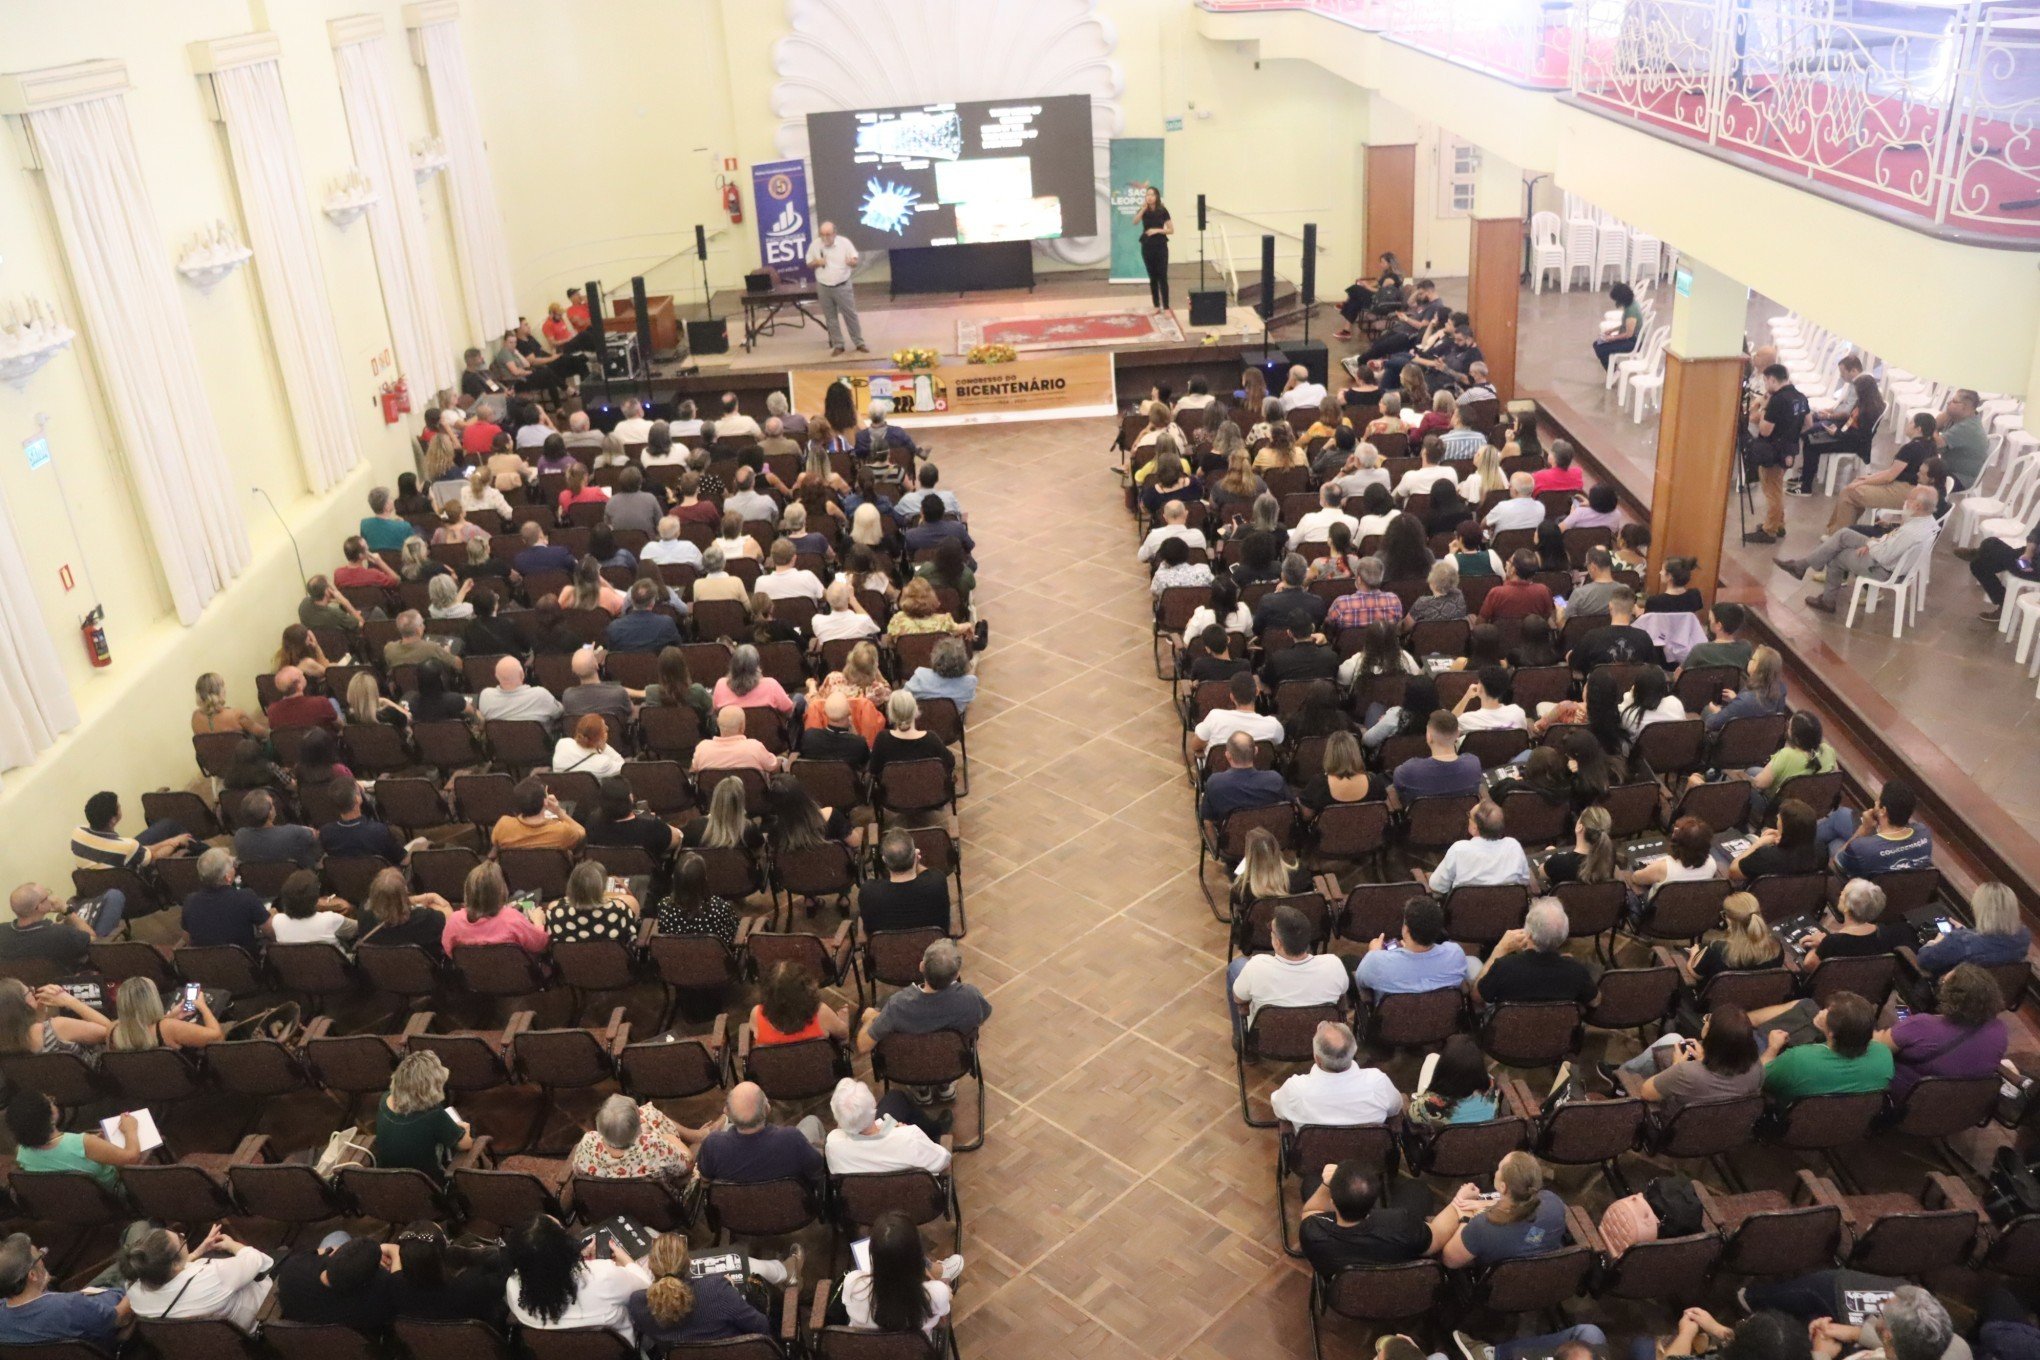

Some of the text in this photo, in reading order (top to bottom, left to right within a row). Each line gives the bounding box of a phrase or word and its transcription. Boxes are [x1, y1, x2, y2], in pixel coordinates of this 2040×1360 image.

[766, 238, 806, 264] EST
[955, 376, 1002, 385] CONGRESSO
[956, 377, 1065, 396] BICENTENÁRIO
